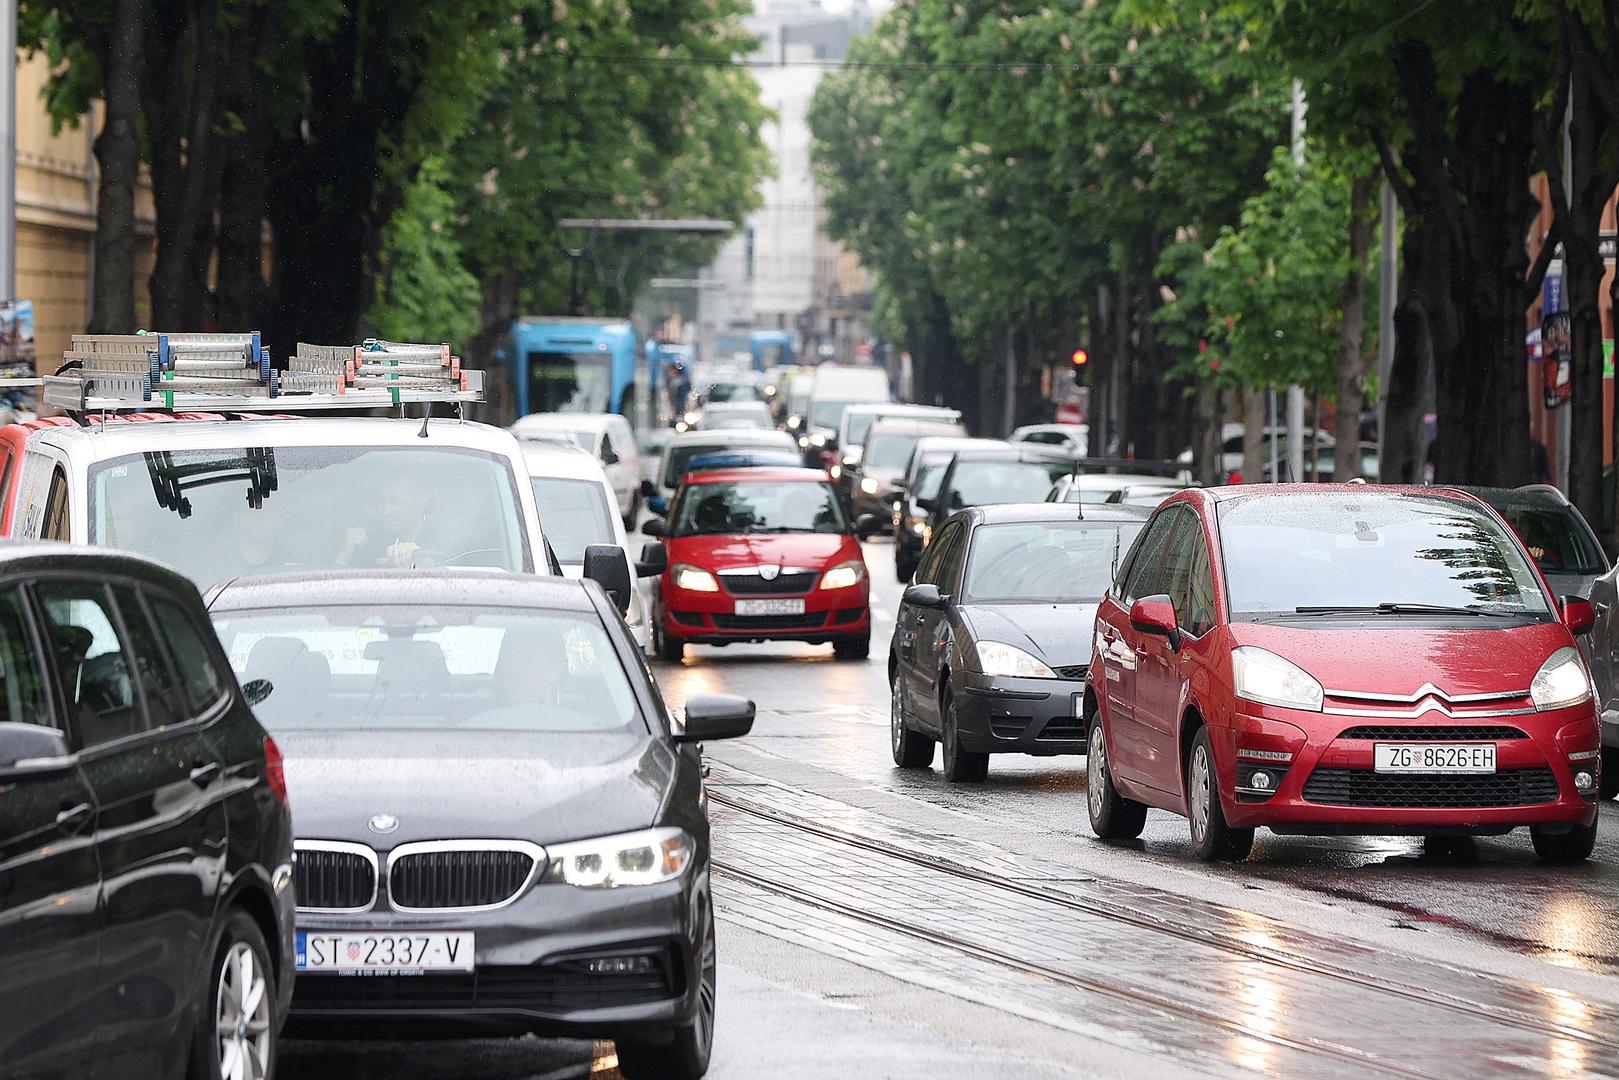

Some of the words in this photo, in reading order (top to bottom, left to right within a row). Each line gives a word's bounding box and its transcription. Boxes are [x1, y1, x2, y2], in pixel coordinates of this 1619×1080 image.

[1389, 748, 1411, 767] ZG
[311, 937, 342, 966] ST
[363, 937, 460, 966] 2337-V
